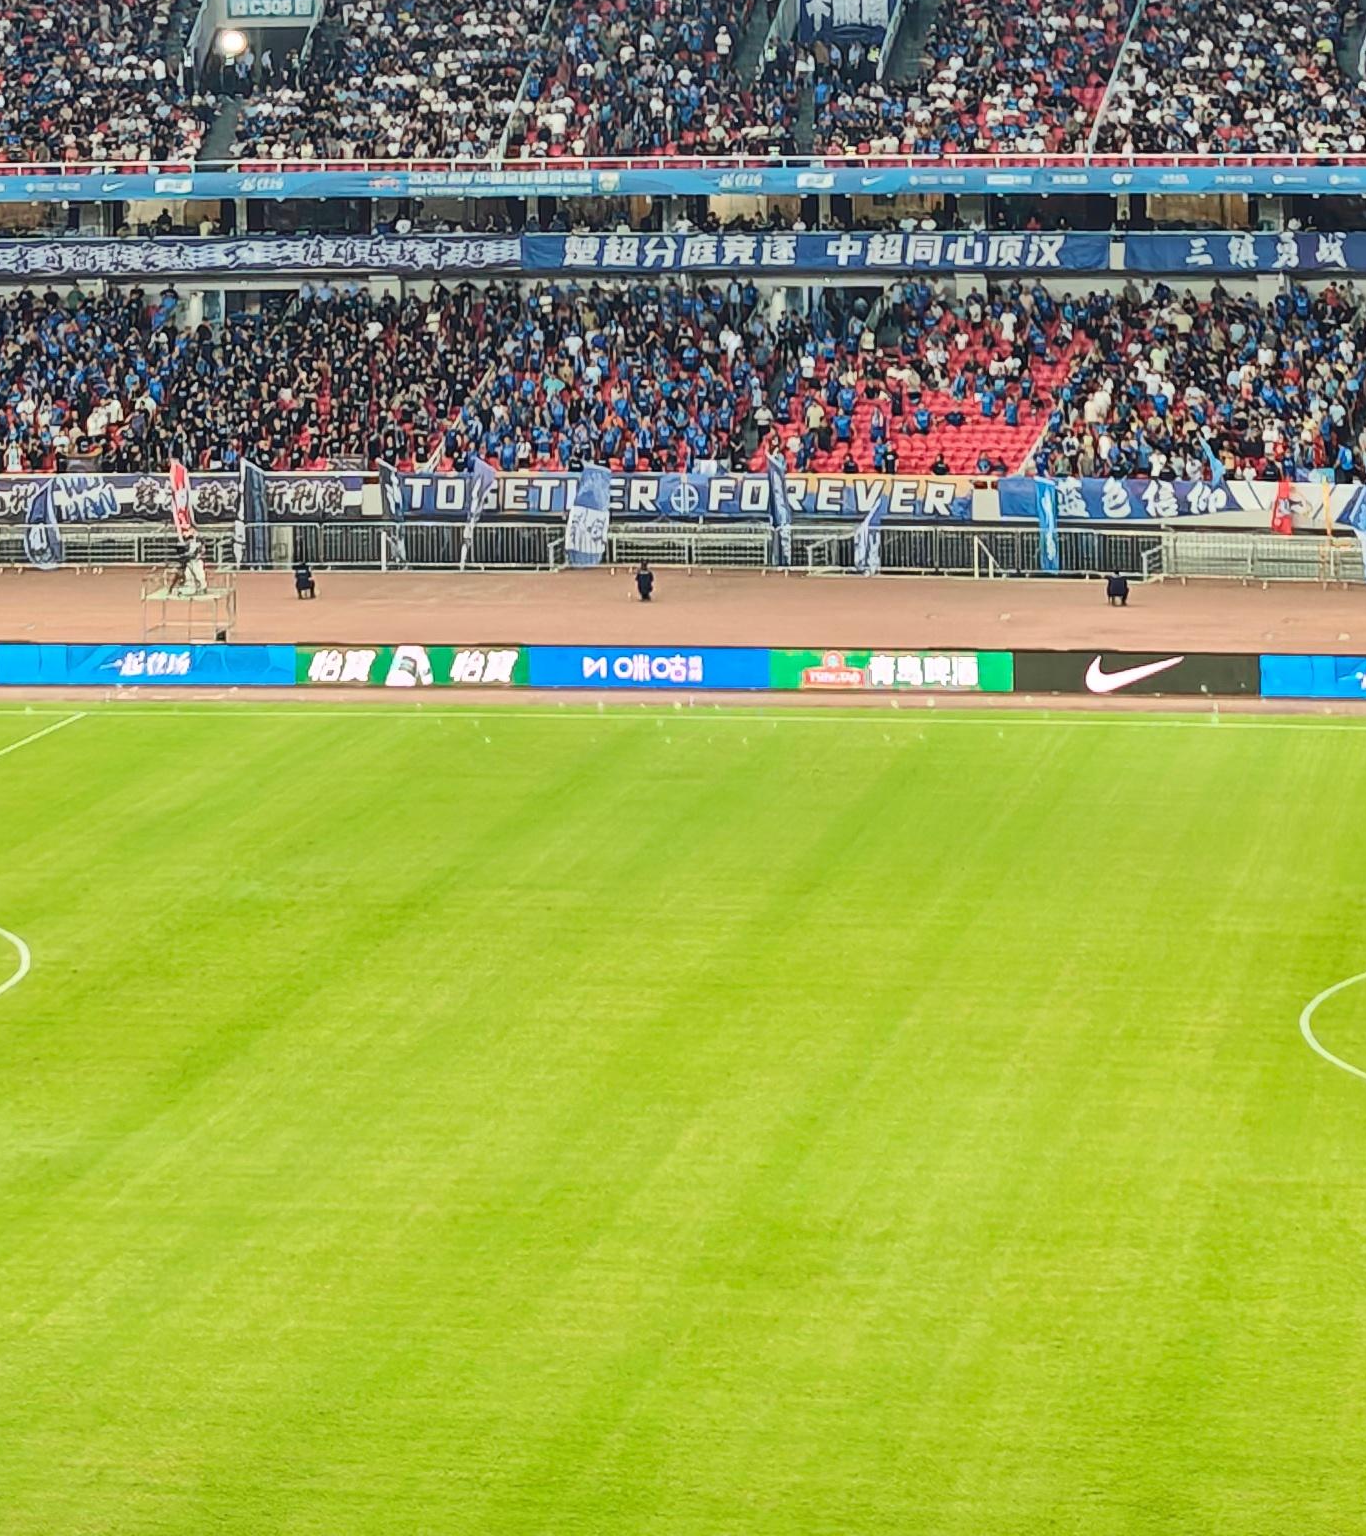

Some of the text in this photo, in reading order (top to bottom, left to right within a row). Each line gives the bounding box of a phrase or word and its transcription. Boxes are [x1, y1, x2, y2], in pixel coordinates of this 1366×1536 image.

[563, 233, 1065, 267] 楚超分庭竞逐 中超同心顶汉
[404, 476, 956, 515] TOGETER FOREVER
[1057, 476, 1227, 519] 蓝色信仰
